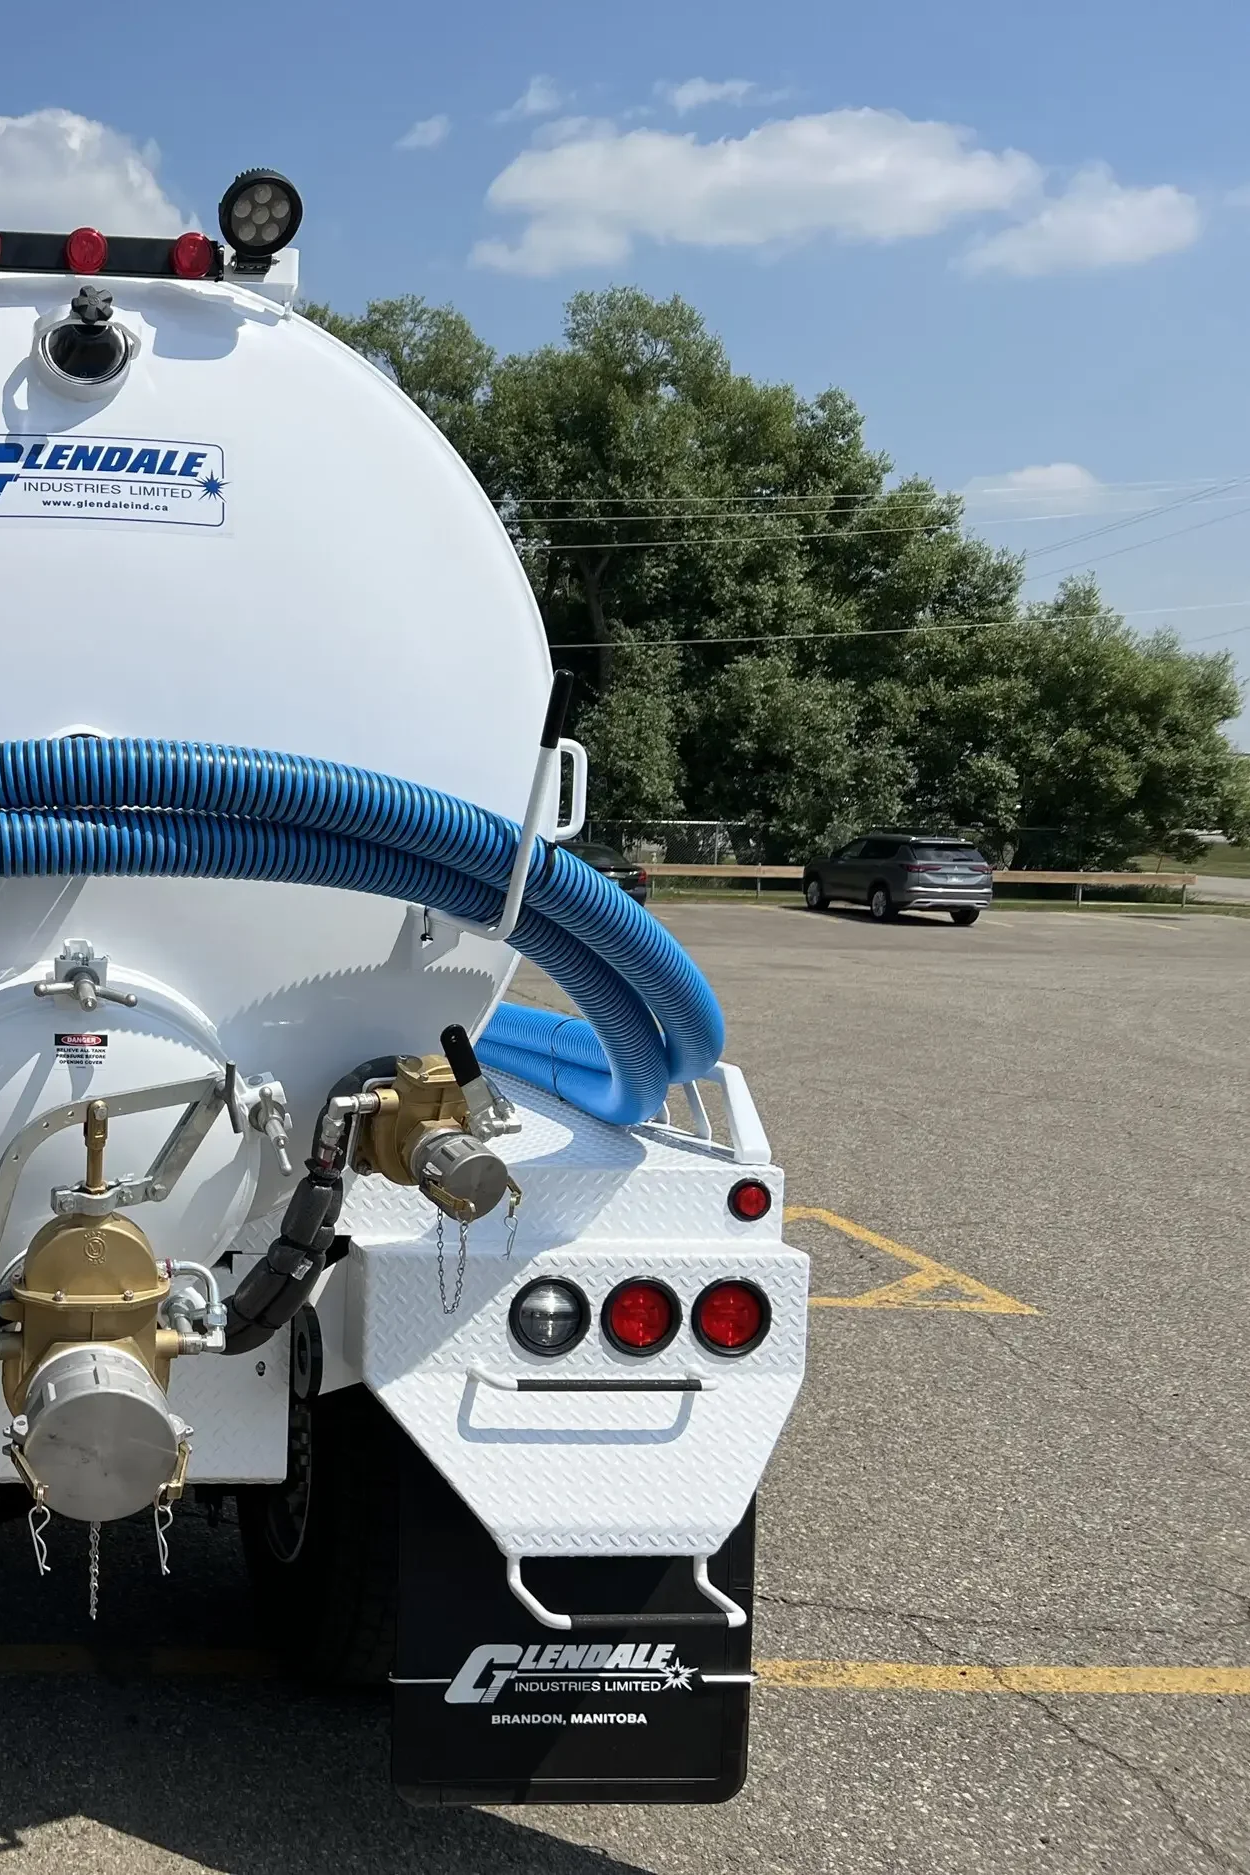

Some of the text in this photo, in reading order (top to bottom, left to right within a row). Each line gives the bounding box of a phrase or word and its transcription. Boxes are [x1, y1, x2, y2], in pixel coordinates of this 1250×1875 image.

[23, 481, 193, 499] INDUSTRIES LIMITED
[42, 498, 169, 512] www.glendaleind.ca
[67, 1036, 96, 1044] DANGER
[444, 1644, 675, 1704] GLENDALE
[514, 1681, 662, 1692] INDUSTRIES LIMITED
[491, 1713, 647, 1725] BRANDON, MANITOBA
